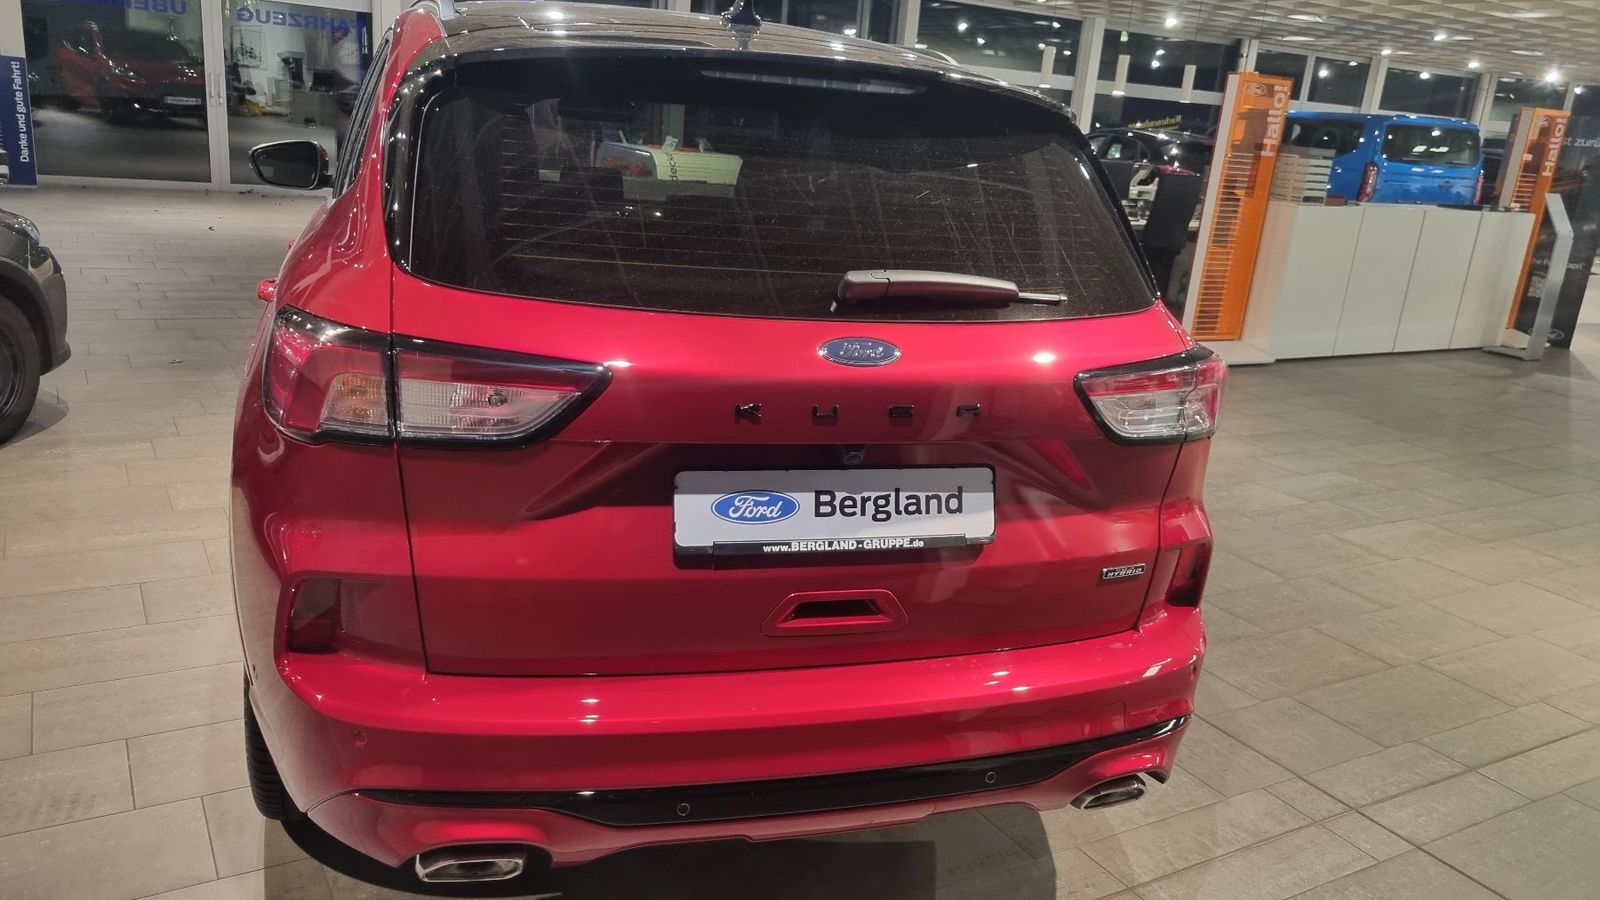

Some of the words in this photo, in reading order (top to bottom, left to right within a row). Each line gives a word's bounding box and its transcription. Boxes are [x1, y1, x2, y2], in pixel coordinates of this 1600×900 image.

[10, 61, 22, 90] Fahrt!
[13, 91, 26, 113] gute
[16, 113, 26, 132] und
[1260, 85, 1289, 157] Hallo!
[19, 133, 30, 162] Danke
[1541, 118, 1567, 177] Hallo!
[728, 495, 784, 520] Ford
[814, 485, 964, 522] Bergland
[1106, 567, 1143, 577] HYBRID
